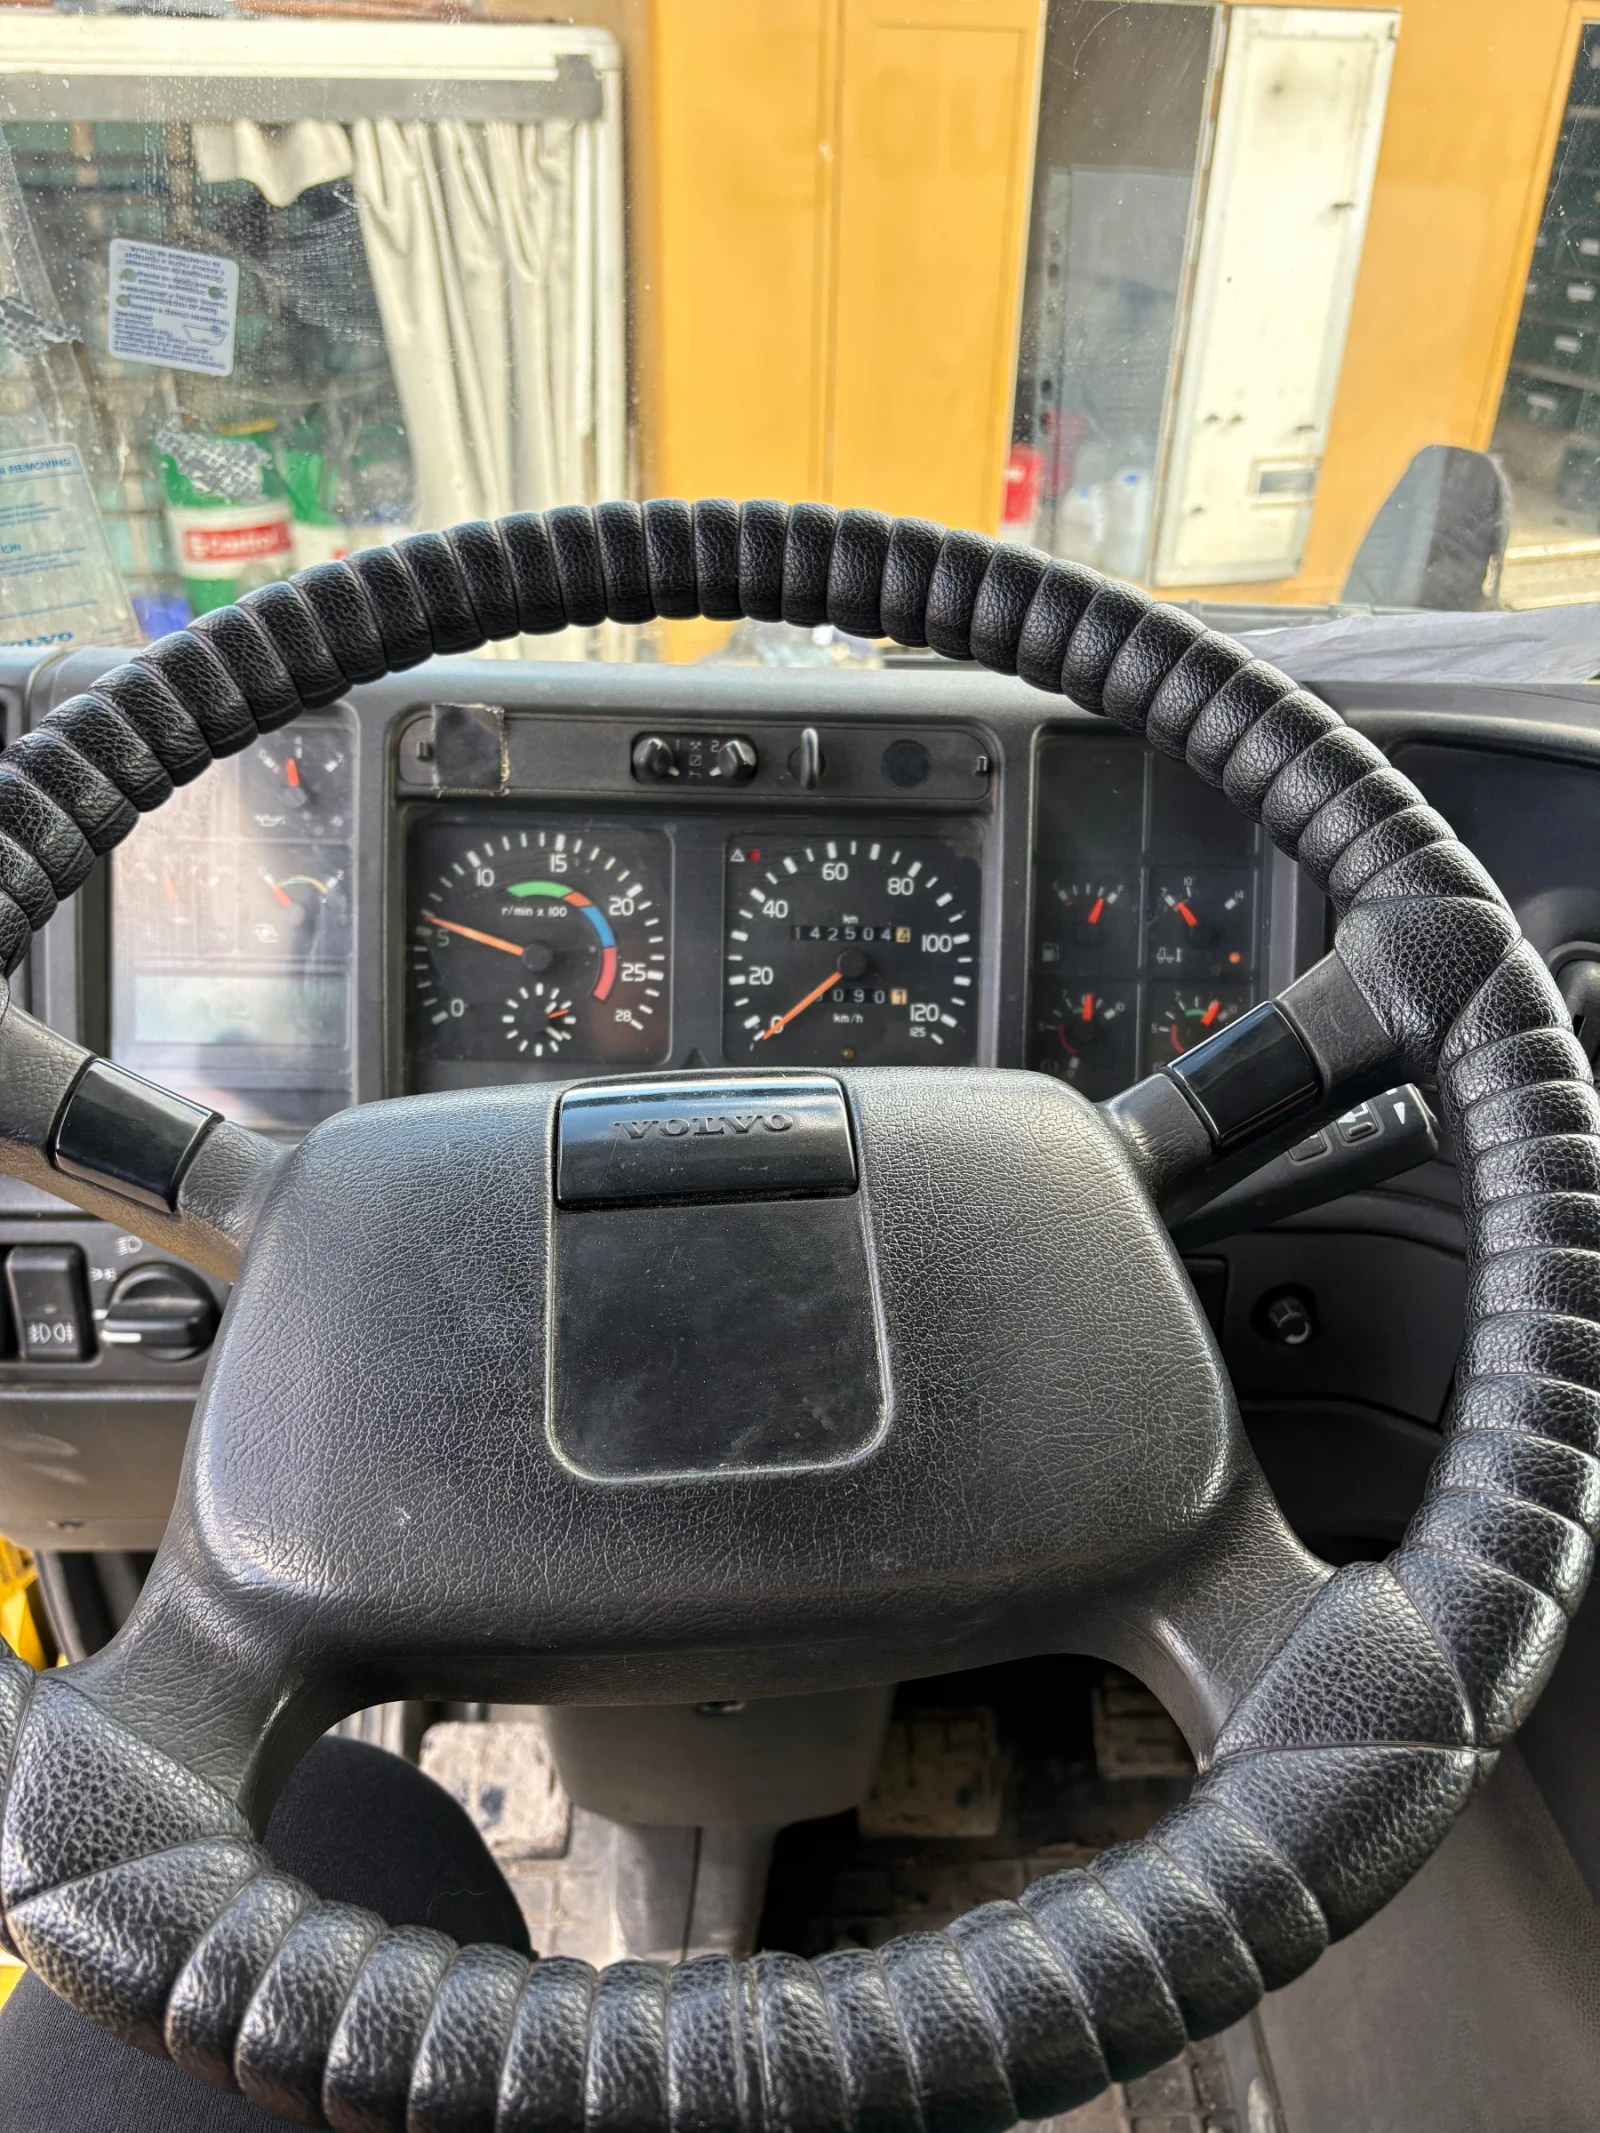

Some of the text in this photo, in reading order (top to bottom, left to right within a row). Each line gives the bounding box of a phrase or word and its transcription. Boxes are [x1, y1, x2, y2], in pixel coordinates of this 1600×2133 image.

[711, 740, 719, 752] 2
[550, 854, 568, 873] 15
[822, 863, 848, 881] 60
[476, 869, 495, 887] 10
[887, 878, 914, 896] 80
[1183, 876, 1193, 887] 10
[1234, 890, 1245, 899] 14
[502, 905, 533, 917] r/min
[548, 906, 567, 918] 100
[609, 898, 634, 916] 20
[763, 900, 788, 918] 40
[843, 914, 858, 924] km
[437, 930, 449, 947] 5
[921, 934, 952, 953] 100
[621, 963, 646, 982] 25
[749, 967, 773, 985] 20
[450, 999, 464, 1017] 0
[615, 1010, 631, 1022] 28
[910, 1004, 939, 1022] 120
[1115, 1002, 1125, 1012] 10
[833, 1014, 864, 1023] km/h
[910, 1027, 926, 1037] 125
[614, 1113, 794, 1140] VOLVO
